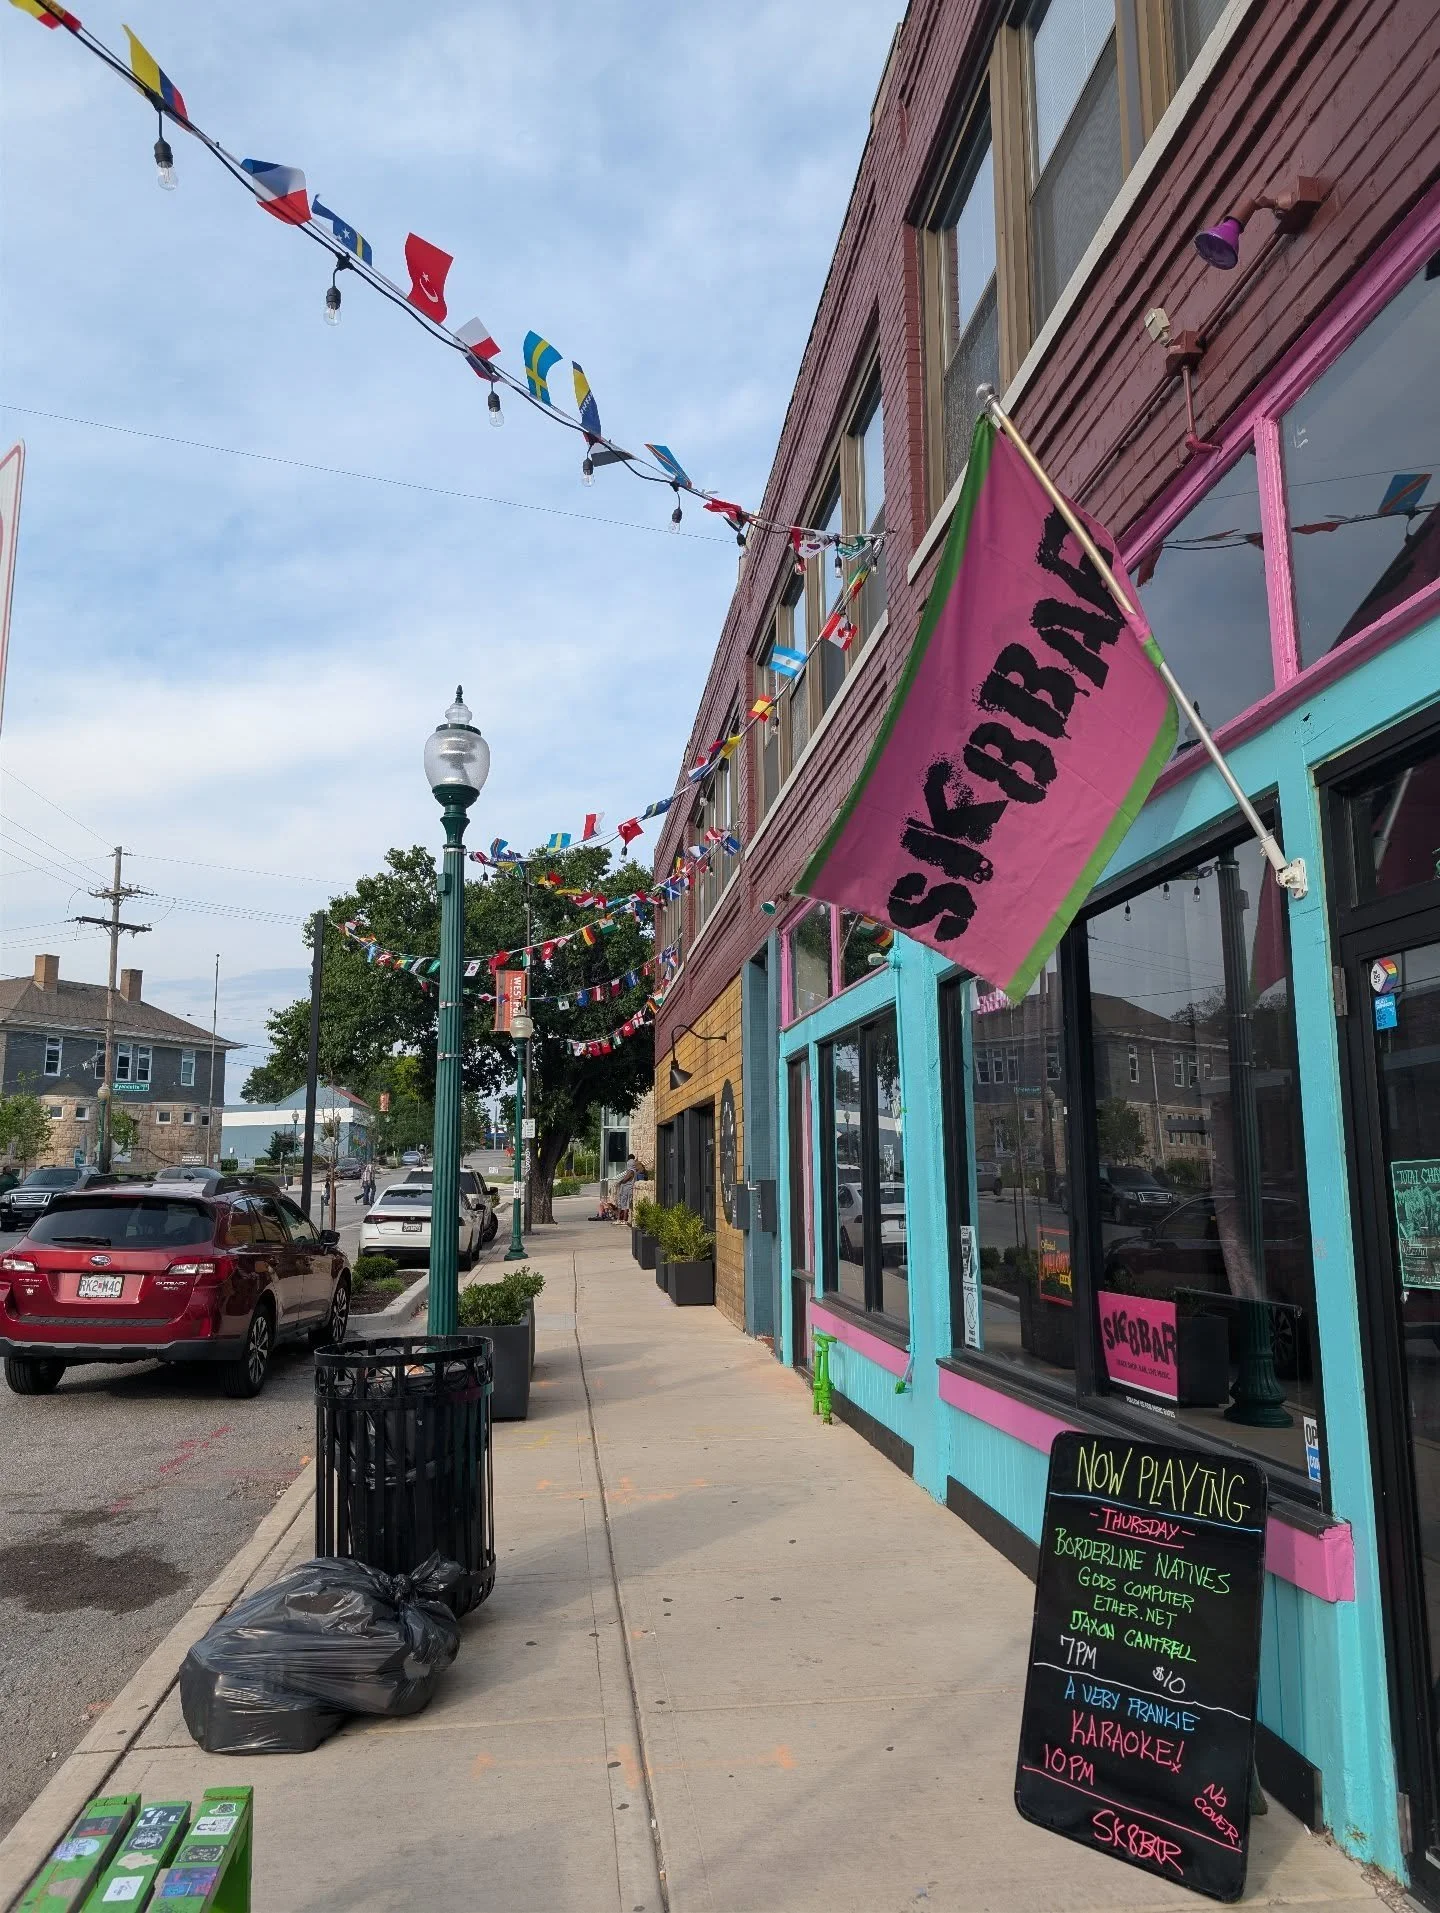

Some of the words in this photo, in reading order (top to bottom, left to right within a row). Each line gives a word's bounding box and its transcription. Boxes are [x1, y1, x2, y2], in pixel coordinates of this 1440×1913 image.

[887, 507, 1128, 943] SK8BAR
[1104, 1310, 1177, 1368] SK8BAR
[1077, 1441, 1133, 1495] NOW
[1138, 1455, 1251, 1523] PLAYING
[1054, 1527, 1147, 1571] BORDERLINE
[1154, 1552, 1231, 1594] NATIVES
[1123, 1581, 1195, 1613] COMPUTER
[1060, 1634, 1097, 1669] 7PM
[1070, 1610, 1115, 1640] JAXON
[1123, 1629, 1197, 1662] CANTRELL
[1064, 1675, 1075, 1700] A
[1082, 1683, 1120, 1710] VERY
[1127, 1697, 1201, 1731] FRANKIE
[1152, 1666, 1186, 1694] $10
[1044, 1743, 1094, 1786] 10PM
[1070, 1709, 1185, 1774] KARAOKE!
[1092, 1809, 1184, 1876] SK8BAR
[1194, 1797, 1239, 1845] COVER
